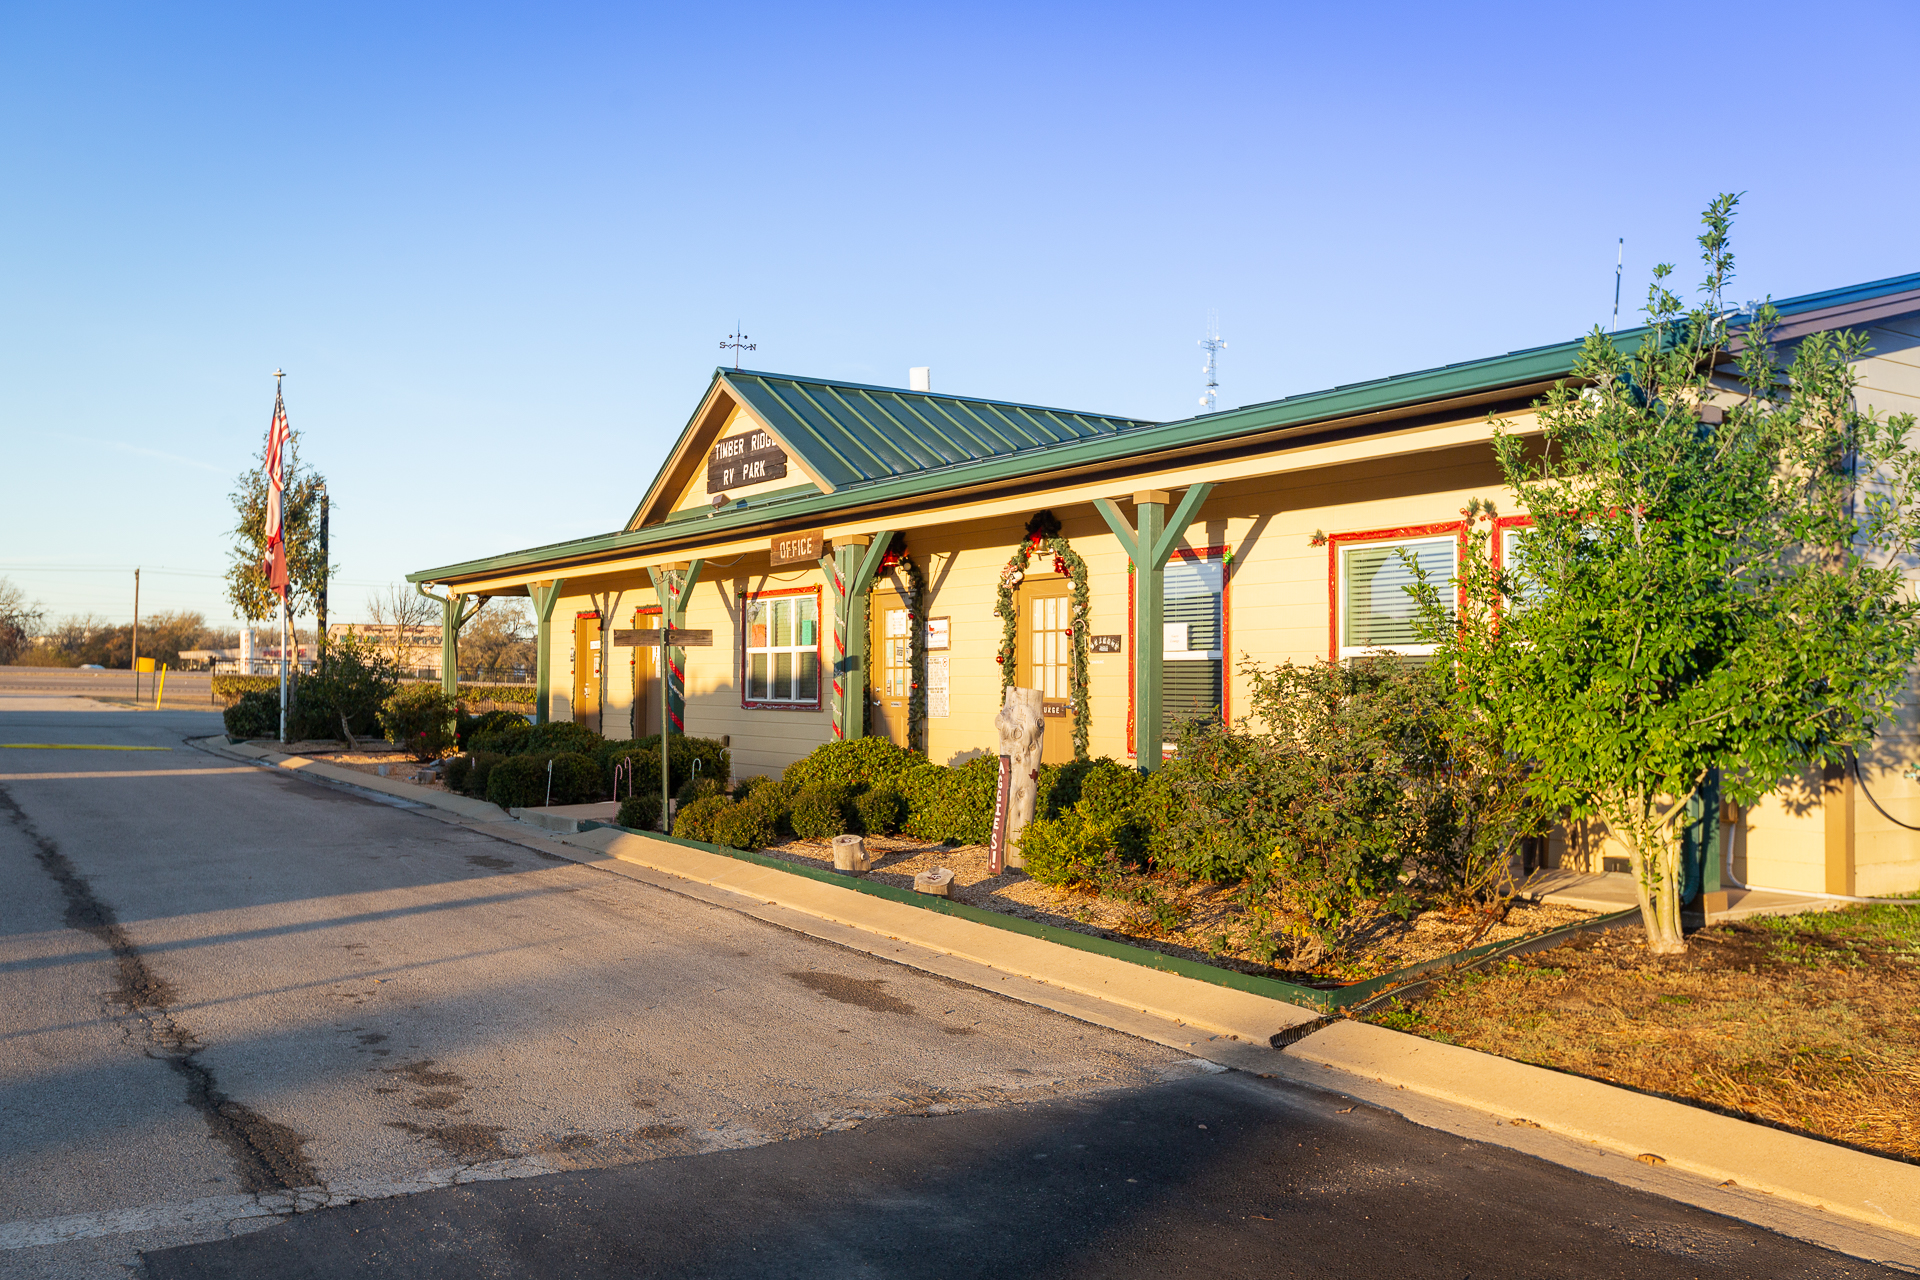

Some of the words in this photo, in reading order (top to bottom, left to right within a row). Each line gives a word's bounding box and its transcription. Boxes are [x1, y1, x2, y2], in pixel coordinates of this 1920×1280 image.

[749, 343, 757, 351] N
[715, 438, 744, 460] TIMBER
[723, 468, 735, 486] RV
[742, 460, 766, 480] PARK
[779, 537, 812, 559] OFFICE
[990, 761, 1005, 869] AGGIES!
